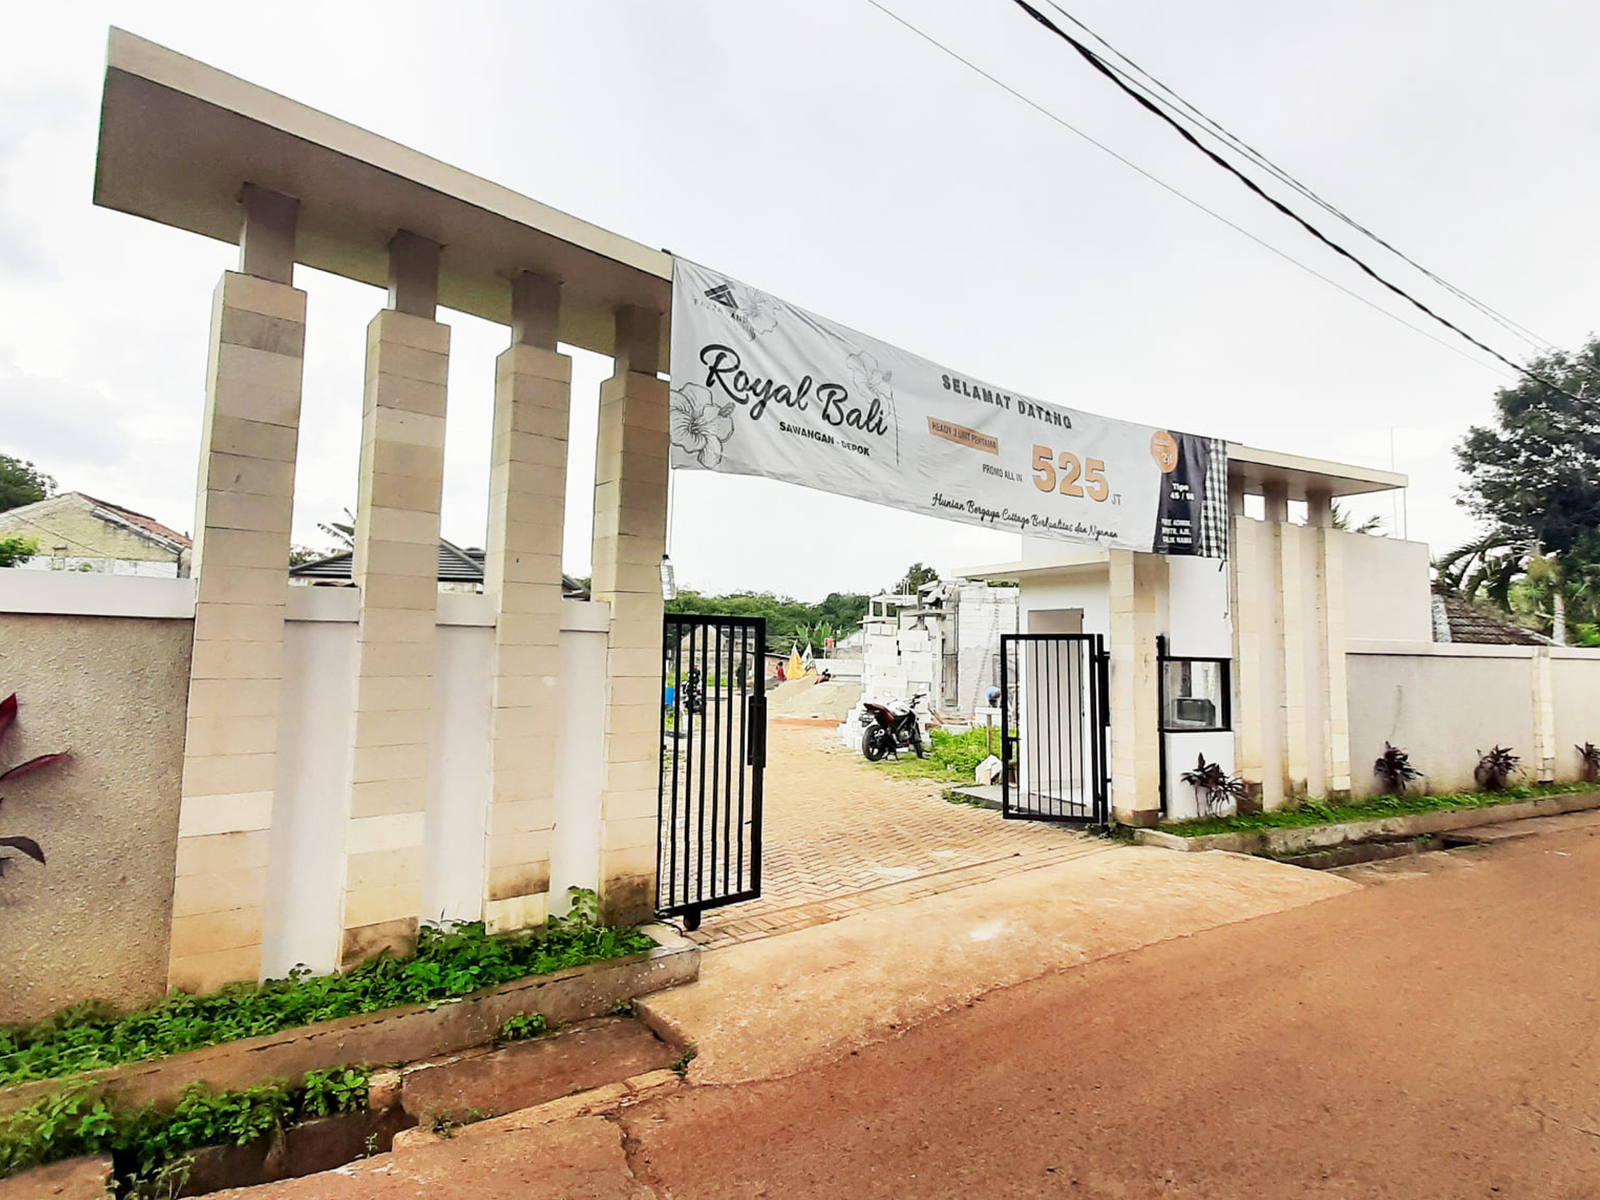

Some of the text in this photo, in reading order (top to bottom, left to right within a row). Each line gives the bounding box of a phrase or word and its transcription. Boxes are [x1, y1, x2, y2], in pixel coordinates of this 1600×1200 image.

[700, 345, 888, 436] Royal Bali
[942, 374, 1072, 429] SELAMAT DATANG
[779, 421, 834, 444] SAWANGAN
[841, 440, 870, 456] DEPOK
[931, 421, 951, 435] READY
[958, 430, 970, 442] UNIT
[971, 434, 997, 449] PERTAMA
[982, 463, 1023, 482] PROMO ALL IN
[1032, 444, 1121, 505] 525 JT
[932, 492, 965, 512] Hunian
[1074, 522, 1088, 535] dan
[1087, 524, 1119, 541] Nyaman
